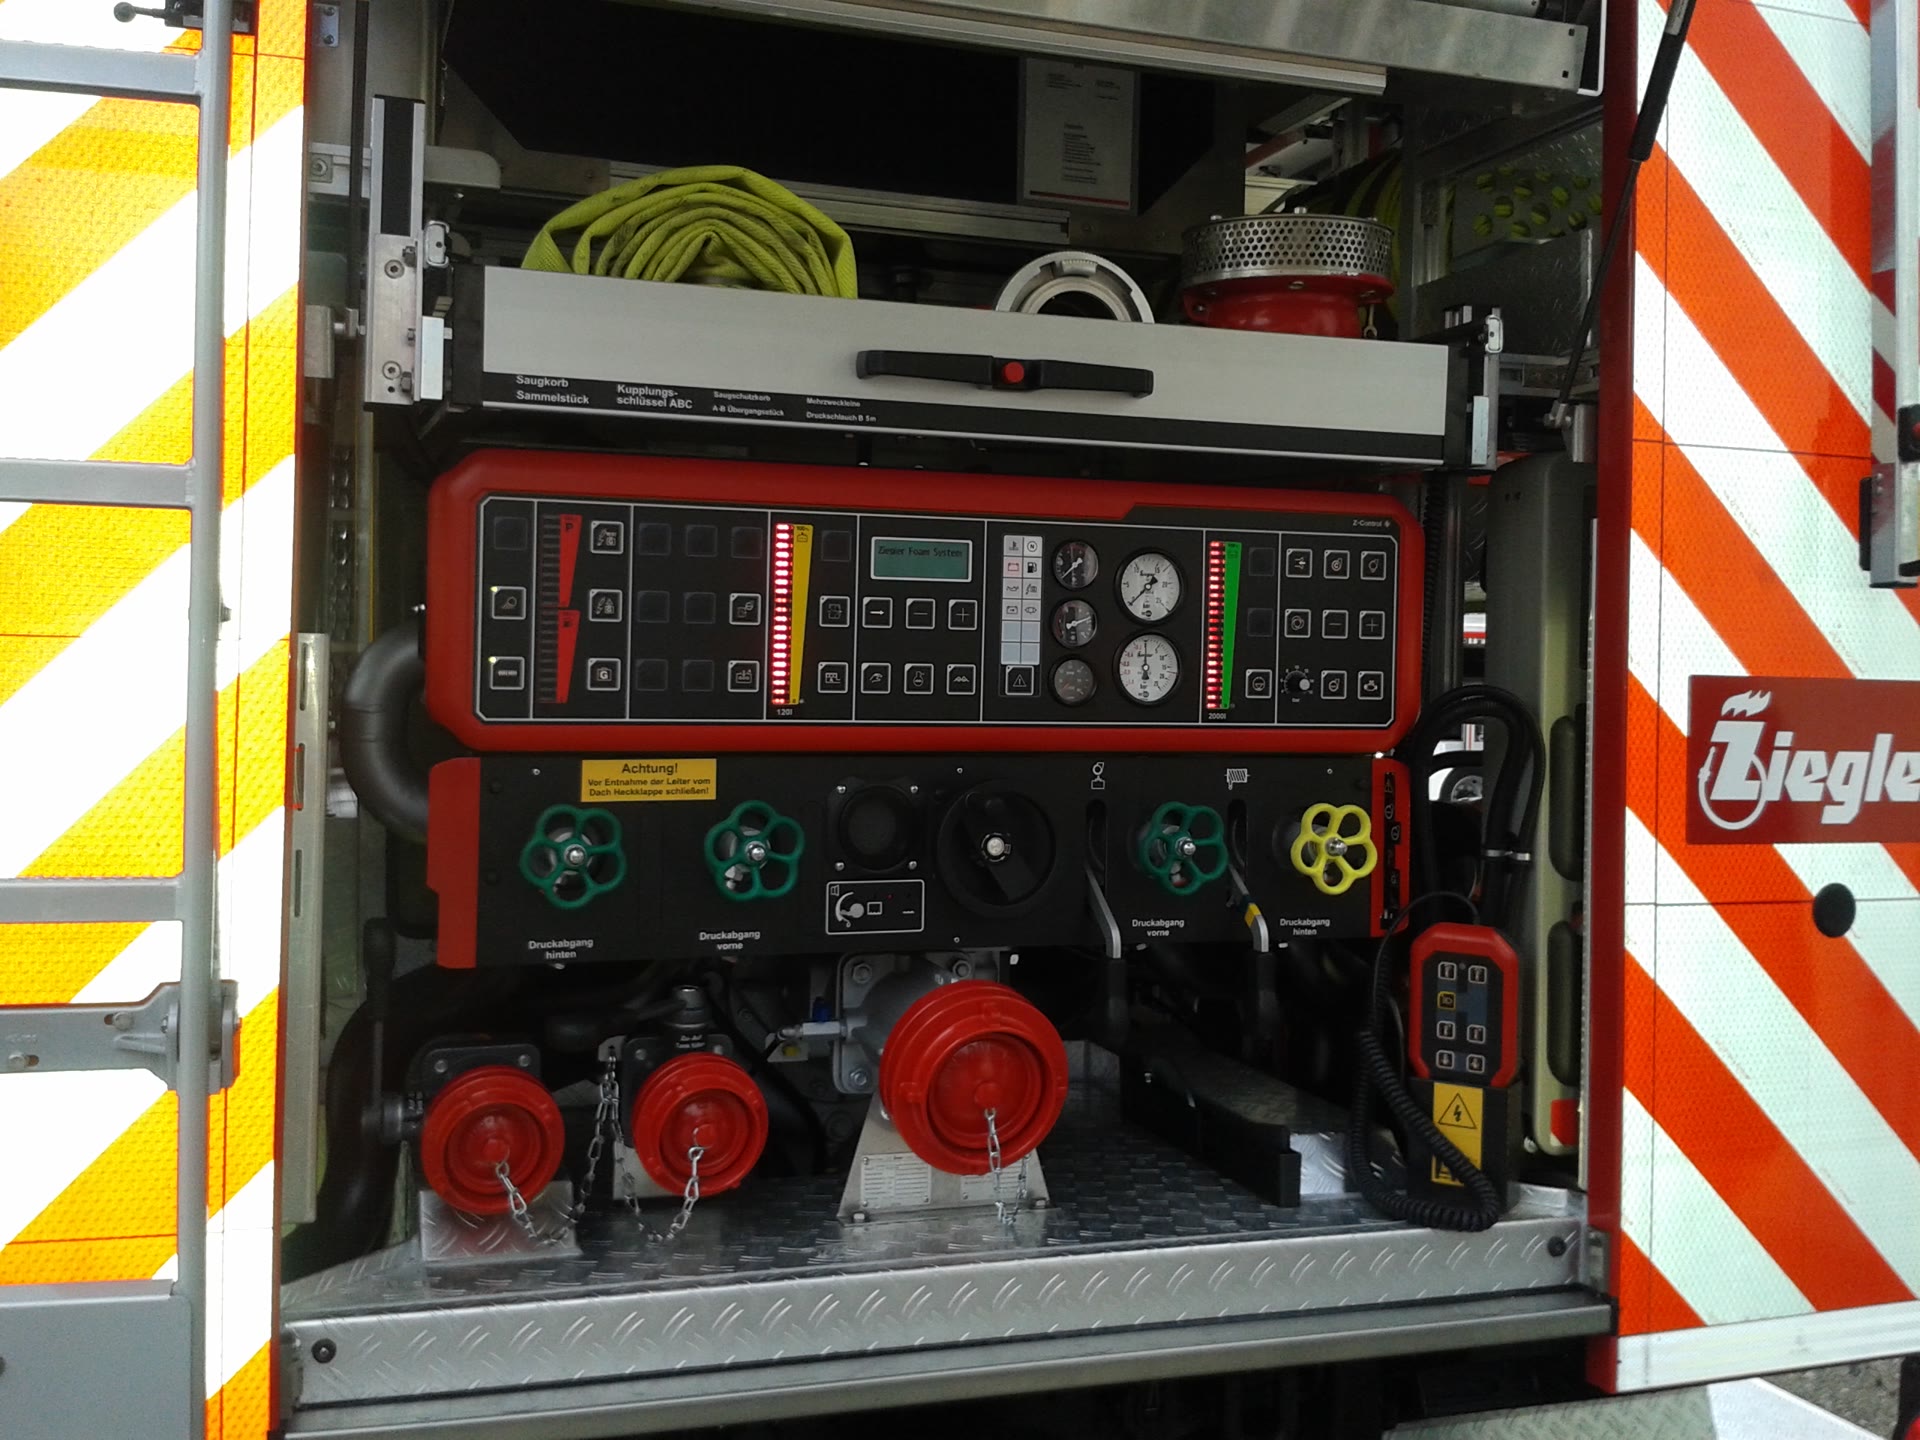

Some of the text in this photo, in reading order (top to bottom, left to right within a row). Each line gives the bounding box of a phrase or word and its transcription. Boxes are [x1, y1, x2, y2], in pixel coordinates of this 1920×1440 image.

[516, 375, 569, 388] Saugkorb
[617, 384, 678, 398] Kupplungs-
[713, 391, 771, 402] Saugschutzkorb
[516, 390, 590, 404] Sammelstück
[617, 396, 693, 409] schlüssel ABC
[806, 411, 857, 422] Druckschlauch
[622, 763, 678, 776] Achtung!
[604, 778, 648, 786] Entnahme
[589, 787, 709, 797] Dach Heckklappe schließen!
[1132, 919, 1185, 928] Druckabgang
[1280, 918, 1331, 927] Druckabgang
[699, 930, 761, 941] Druckabgang
[1293, 928, 1317, 936] hinten
[528, 938, 594, 950] Druckabgang
[717, 942, 743, 950] vorne
[545, 950, 577, 959] hinten
